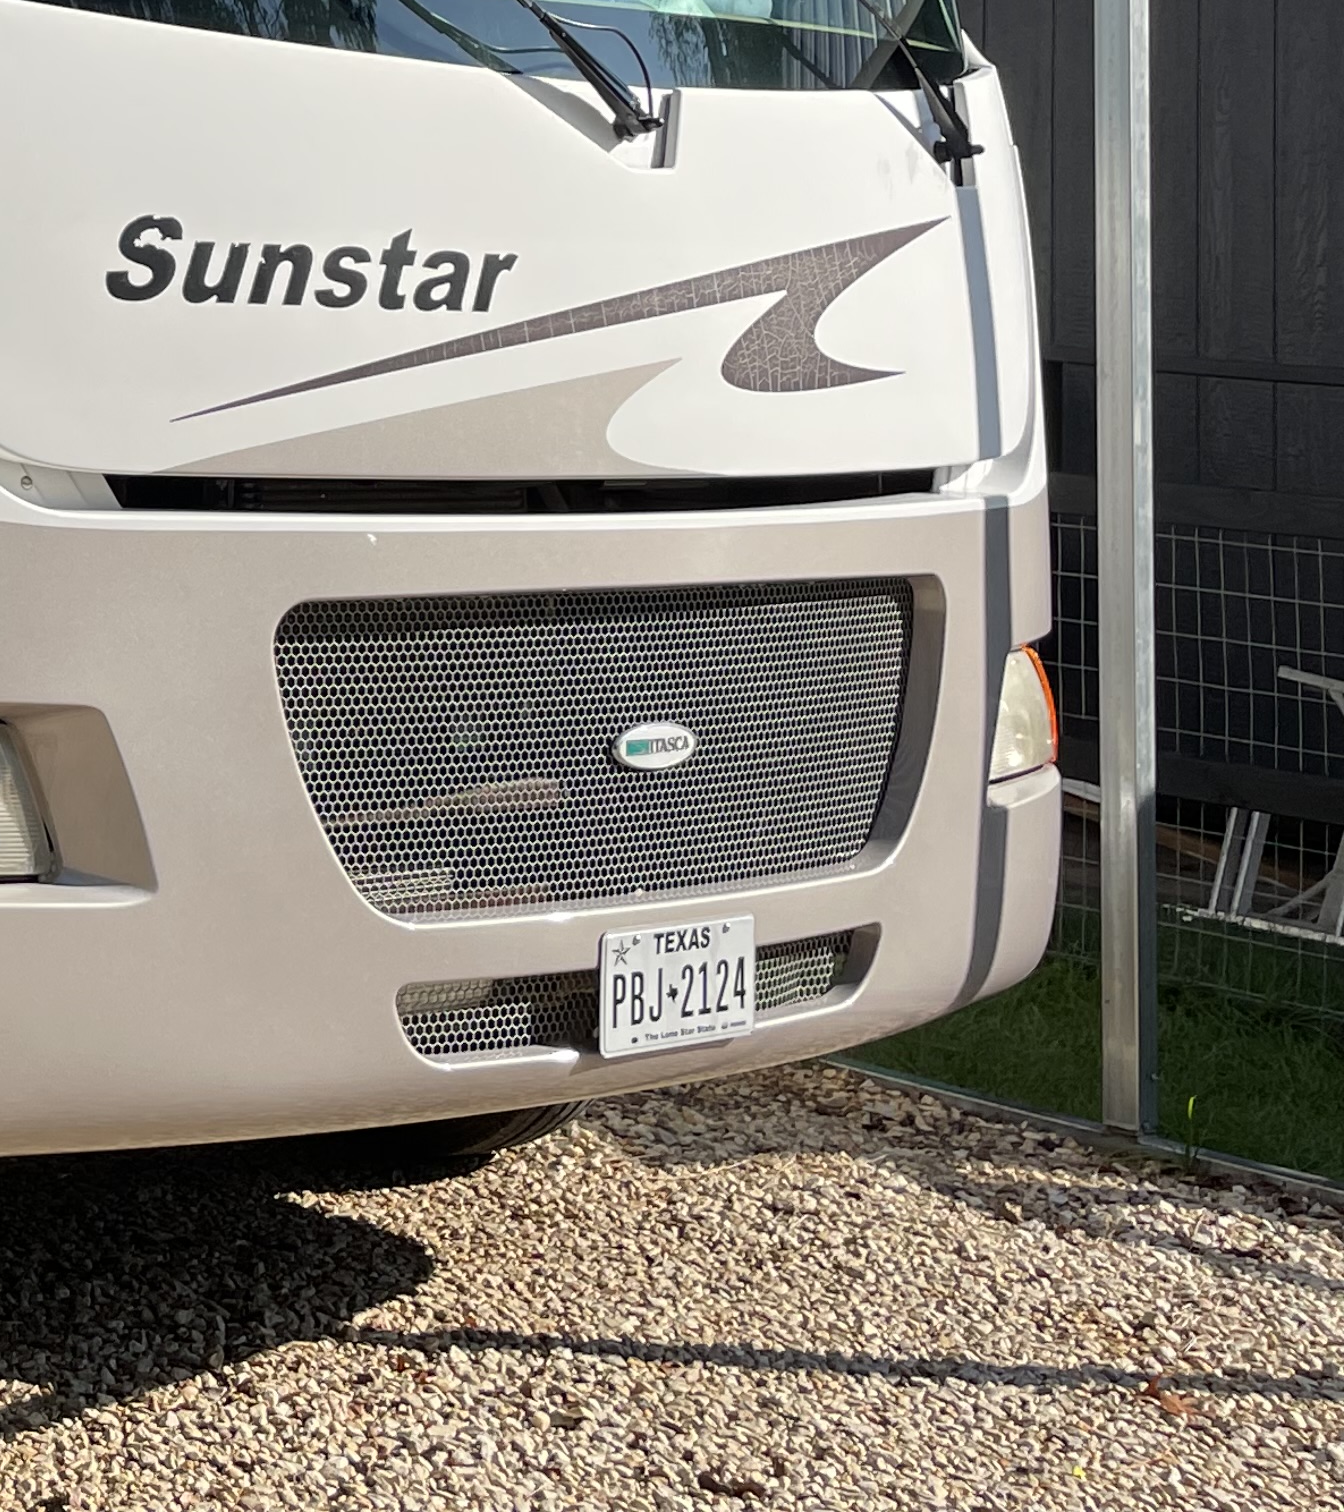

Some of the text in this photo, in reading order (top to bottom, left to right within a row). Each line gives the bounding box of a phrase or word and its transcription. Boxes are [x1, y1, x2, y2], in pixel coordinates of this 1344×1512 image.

[105, 214, 519, 313] Sunstar
[650, 735, 689, 755] ITASCA
[653, 926, 711, 955] TEXAS
